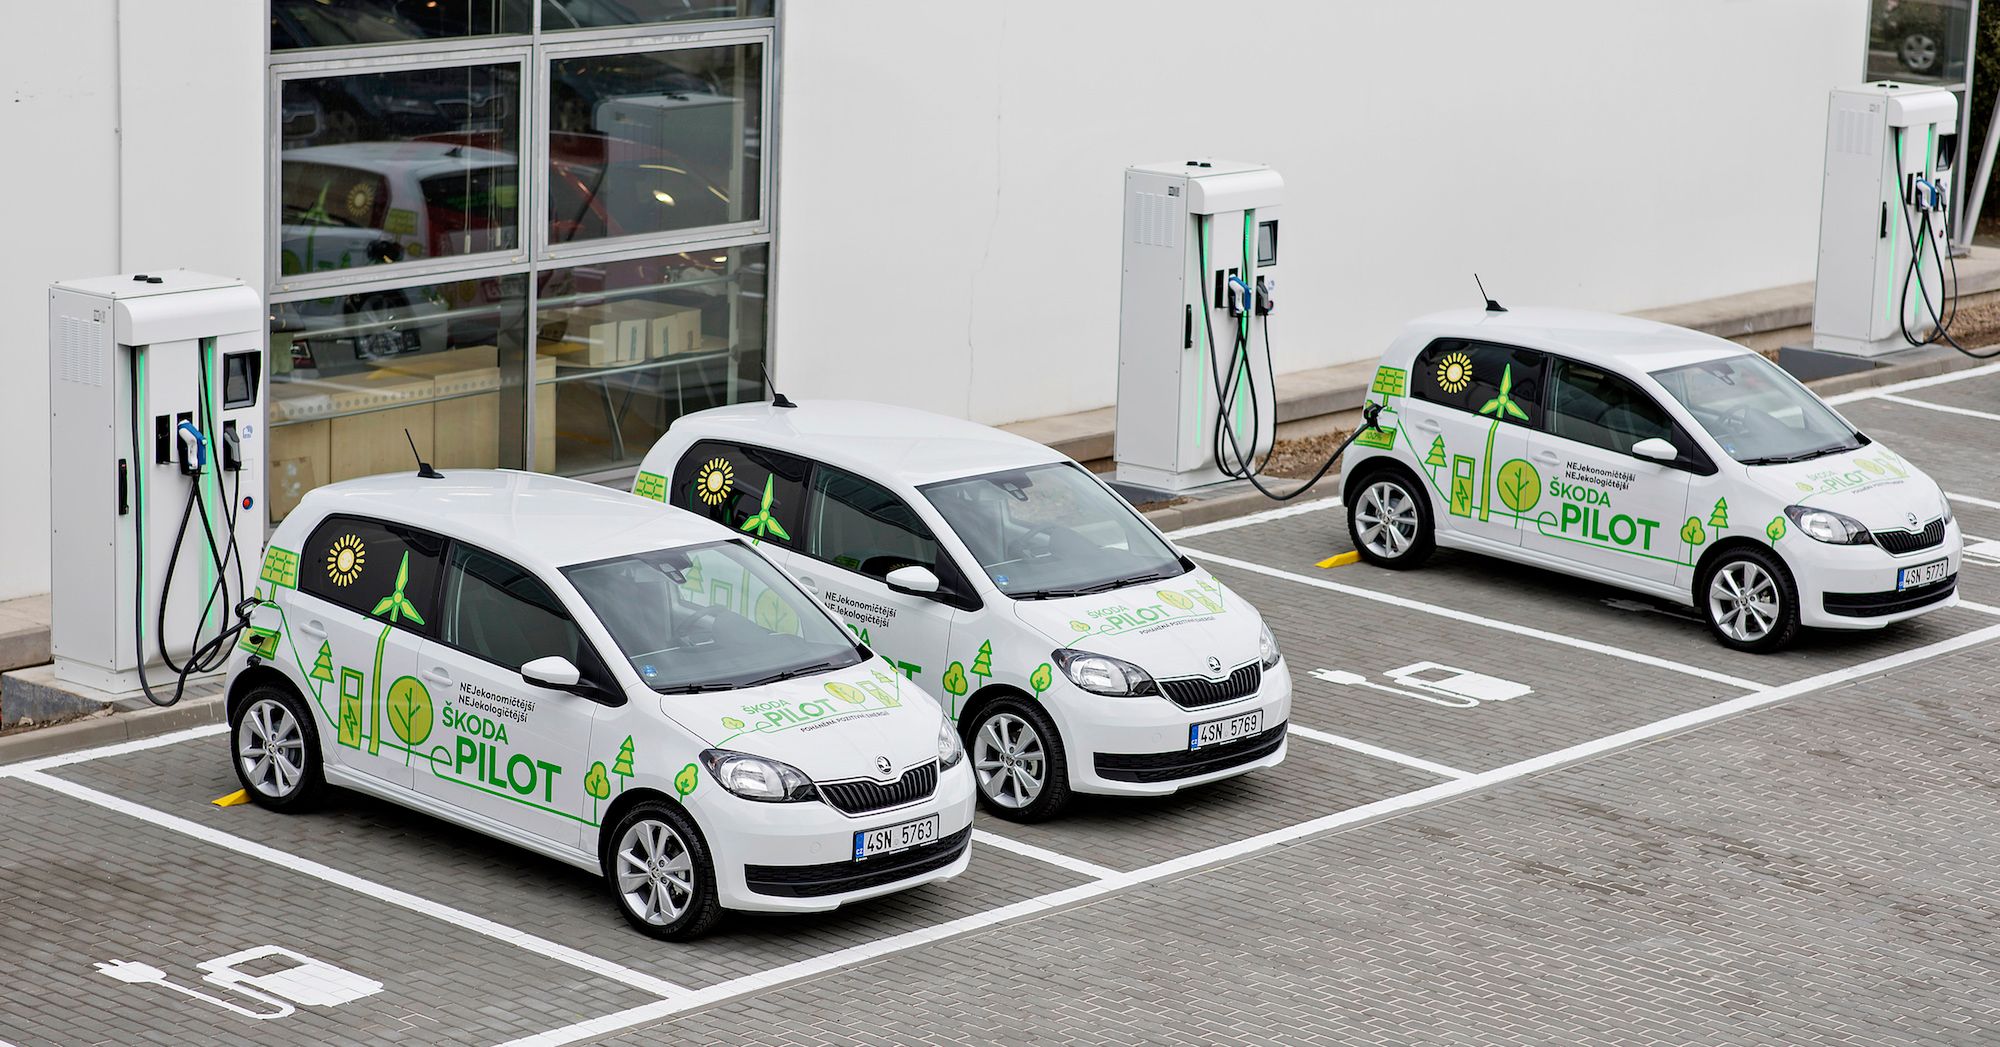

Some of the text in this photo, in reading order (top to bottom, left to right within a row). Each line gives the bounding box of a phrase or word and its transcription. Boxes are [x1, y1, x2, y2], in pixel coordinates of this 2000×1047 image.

[1565, 471, 1629, 491] NEJekologičtější
[1566, 461, 1636, 482] NEJekonomičtější
[1549, 476, 1611, 508] ŠKODA
[1537, 502, 1660, 551] ePILOT
[1905, 568, 1921, 584] 4SN
[1926, 562, 1944, 580] 5773
[825, 591, 897, 618] NEJekonomičtější
[1087, 604, 1131, 619] ŠKODA
[458, 694, 529, 723] NEJekologičtější
[459, 682, 536, 712] NEJekonomičtější
[741, 698, 791, 715] ŠKODA
[442, 700, 509, 745] ŠKODA
[1201, 714, 1257, 742] 4SN 5769
[431, 735, 562, 803] ePILOT
[867, 820, 932, 852] 4SN 5763
